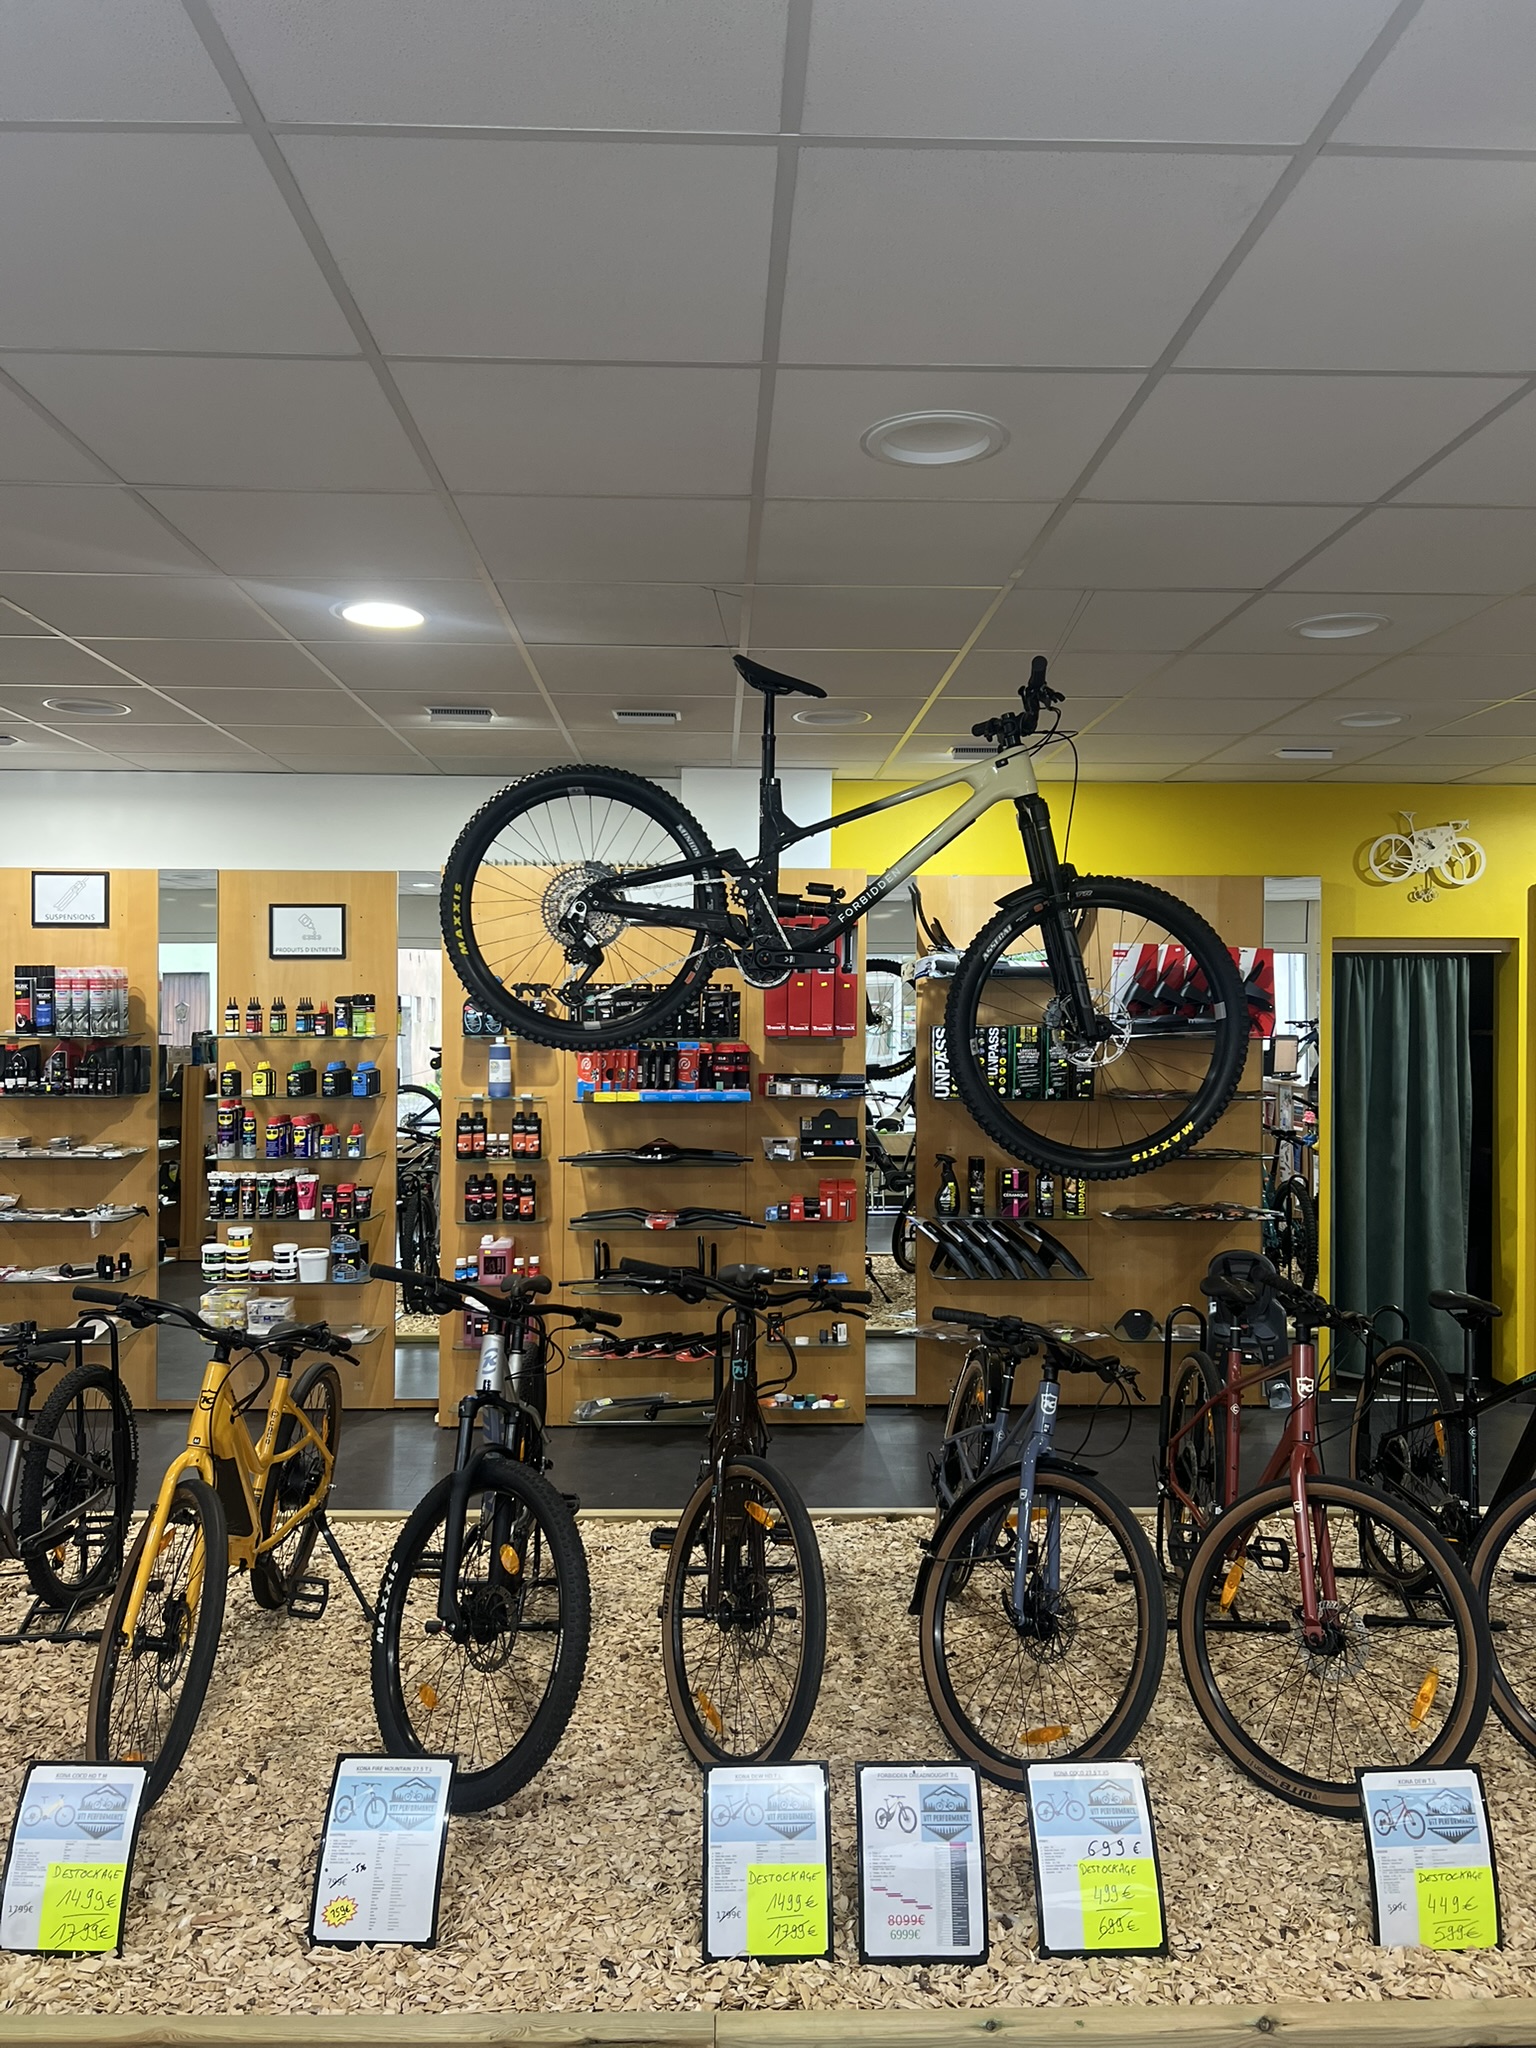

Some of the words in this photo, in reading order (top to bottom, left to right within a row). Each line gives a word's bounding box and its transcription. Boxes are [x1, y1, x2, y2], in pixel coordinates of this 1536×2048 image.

[838, 868, 902, 923] FORBIDDEN
[45, 913, 96, 921] SUSPENSIONS
[453, 883, 469, 956] MAXXIS
[987, 1027, 999, 1075] UNPASS
[935, 1027, 950, 1098] UNPASS
[1131, 1120, 1195, 1162] MAXXIS
[376, 1560, 399, 1644] MAXXIS
[399, 1804, 434, 1812] PERFORMANCE
[1100, 1807, 1136, 1816] PERFORMANCE
[87, 1813, 124, 1821] PERFORMANCE
[777, 1812, 814, 1820] PERFORMANCE
[923, 1814, 932, 1822] VTT
[933, 1814, 970, 1822] PERFORMANCE
[1438, 1817, 1475, 1826] PERFORMANCE
[53, 1865, 123, 1881] DESTOCKAGE
[1079, 1862, 1137, 1876] DESTOCKAGE
[748, 1870, 821, 1885] DESTOCKAGE
[1418, 1871, 1483, 1884] DESTOCKAGE
[888, 1914, 926, 1926] 8099€
[890, 1929, 921, 1940] 6999€
